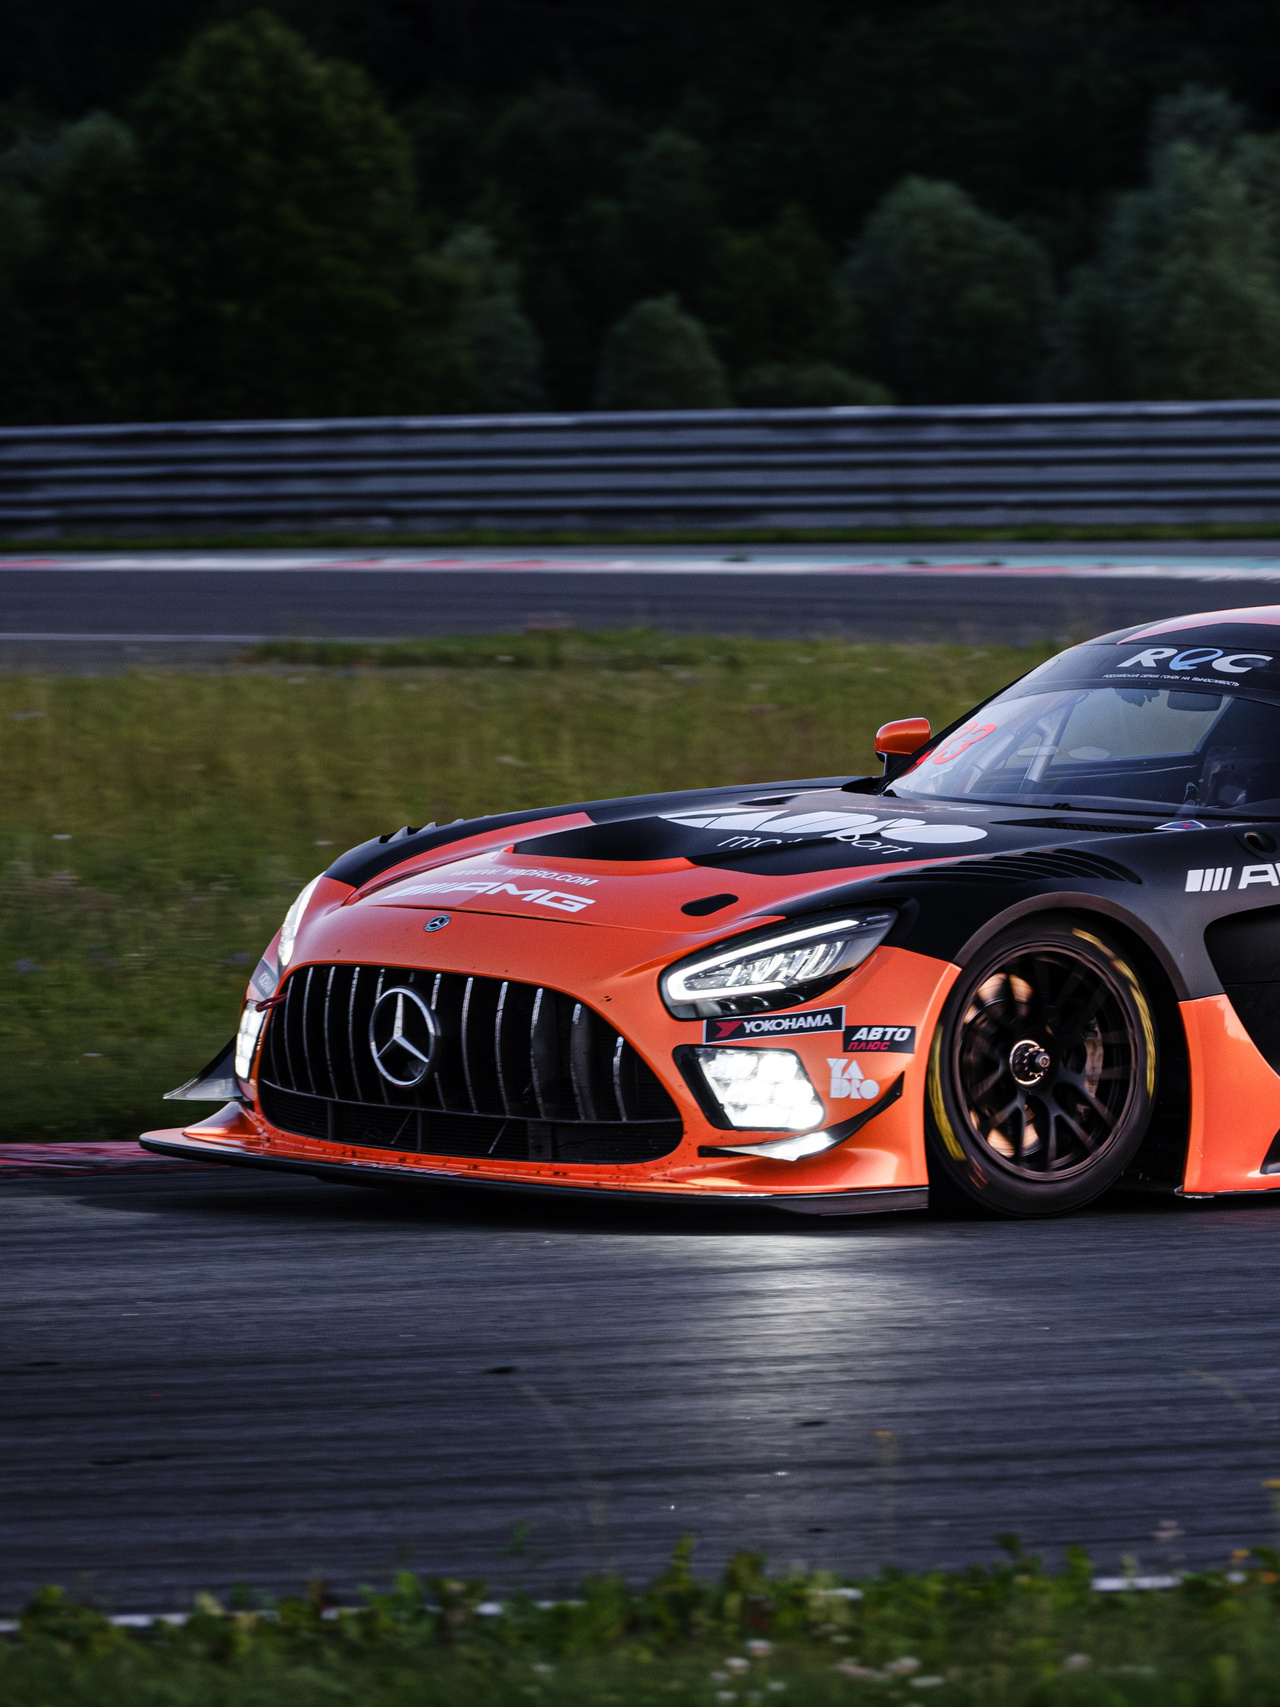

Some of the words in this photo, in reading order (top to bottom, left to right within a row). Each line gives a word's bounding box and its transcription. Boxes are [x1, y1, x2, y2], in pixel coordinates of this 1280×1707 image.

[442, 881, 597, 913] AMG
[744, 1013, 834, 1034] YOKOHAMA
[851, 1027, 912, 1042] АВТО
[847, 1041, 891, 1051] ПЛЮС
